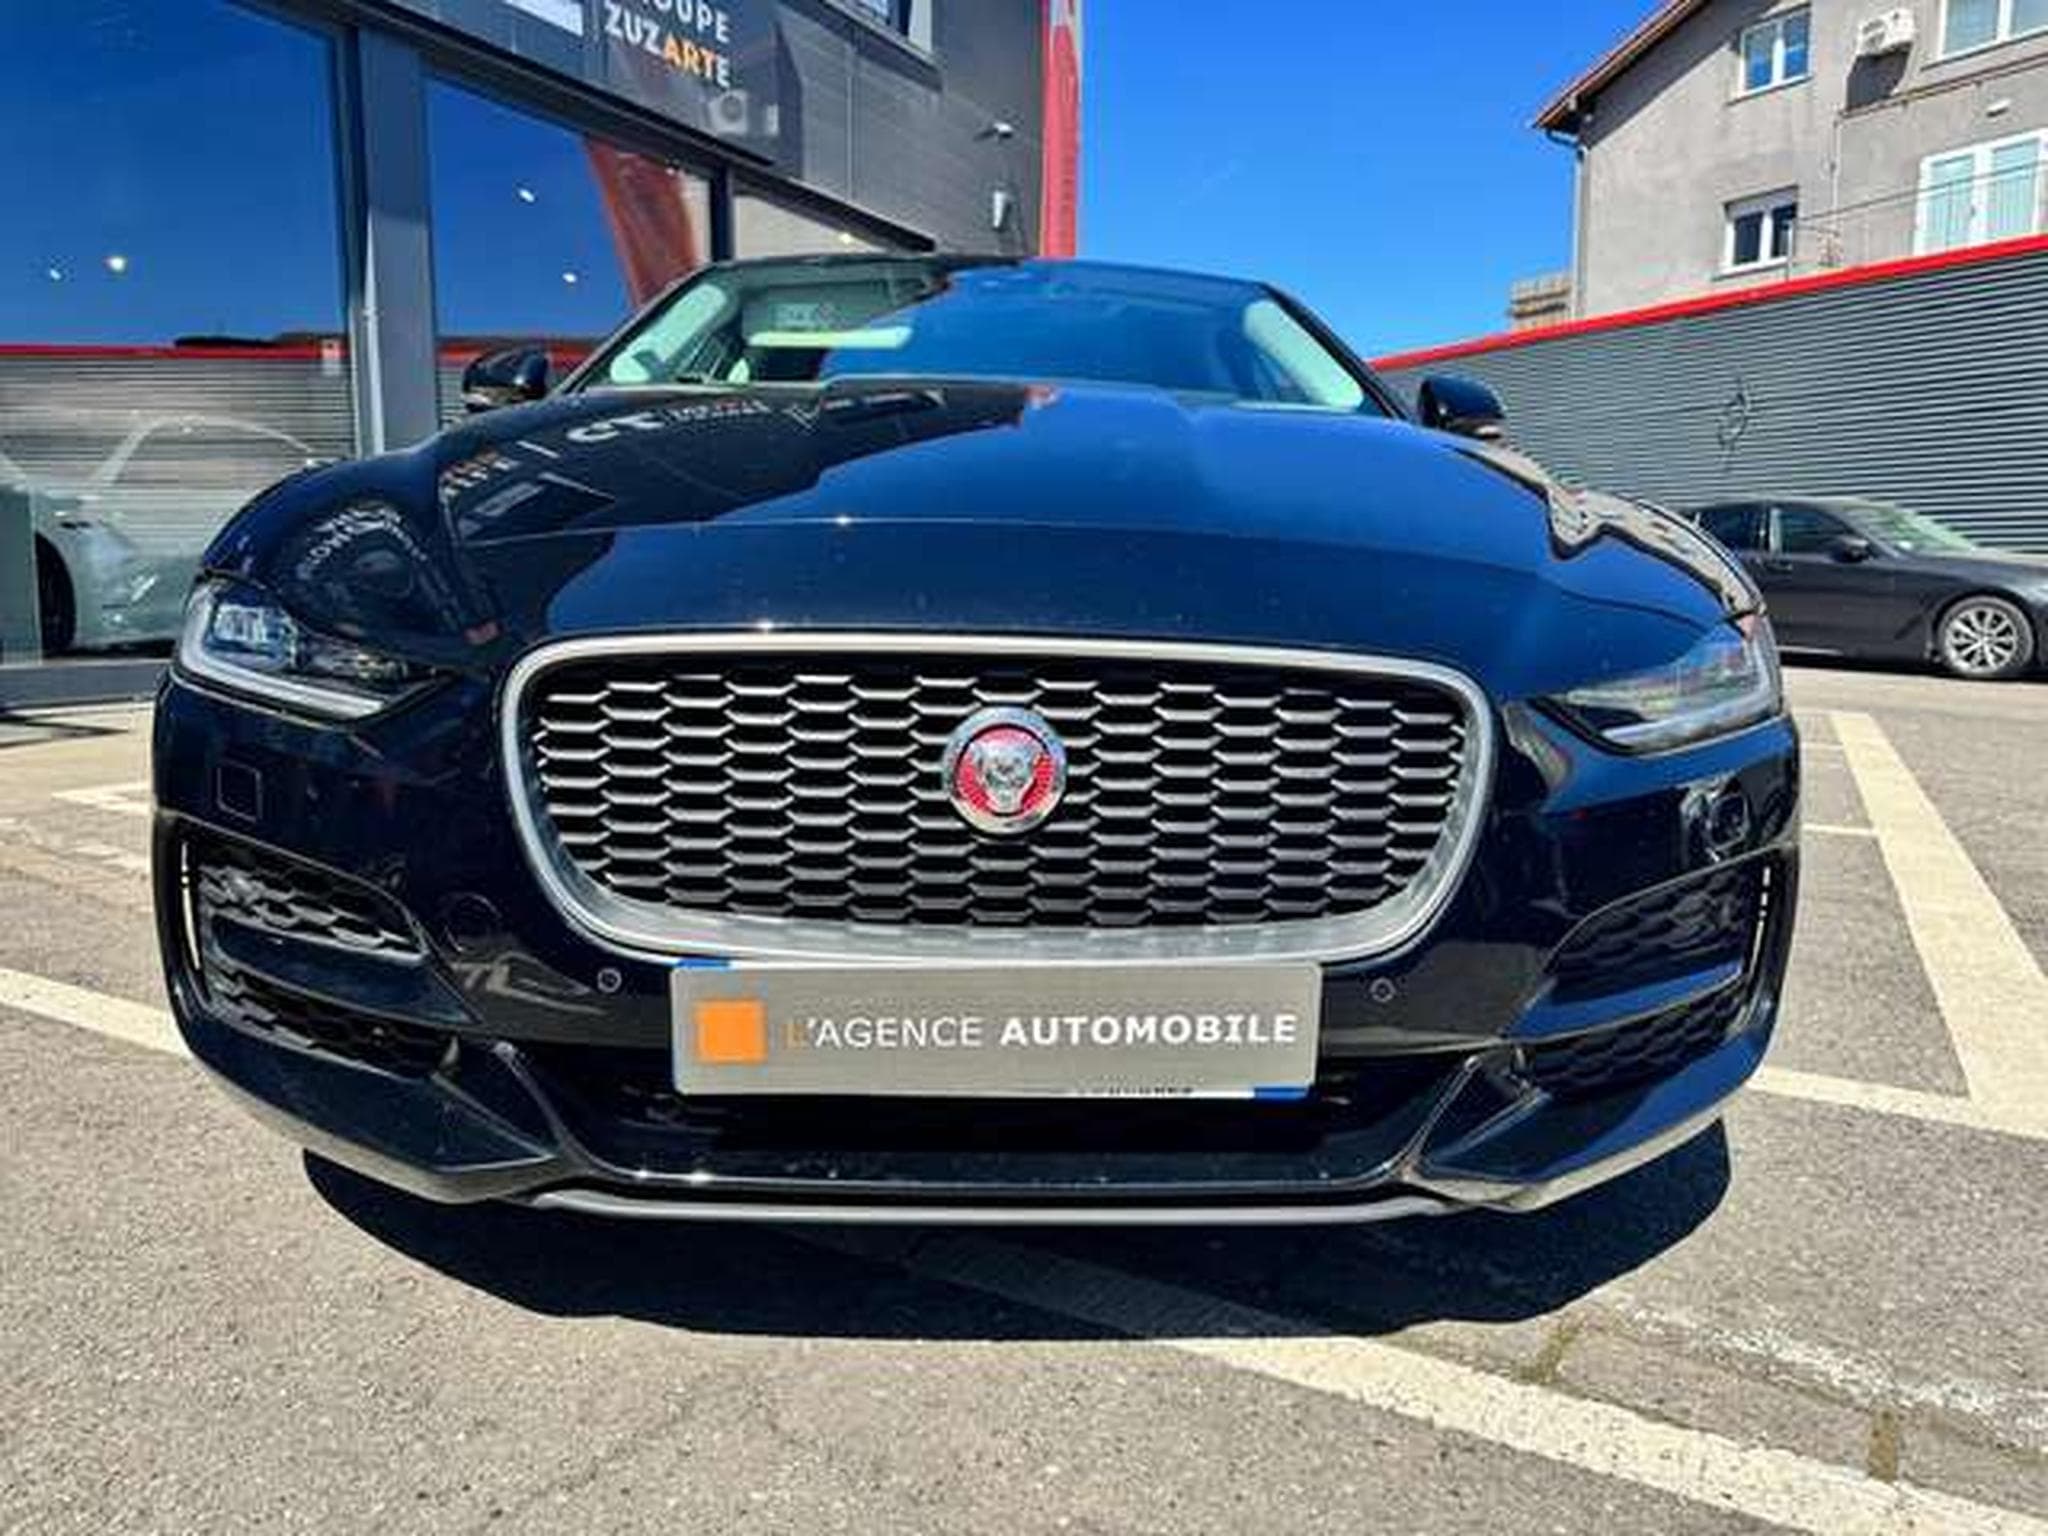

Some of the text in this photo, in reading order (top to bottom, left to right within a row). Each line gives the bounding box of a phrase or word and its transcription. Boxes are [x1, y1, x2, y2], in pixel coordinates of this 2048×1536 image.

[643, 0, 730, 43] UPE
[604, 0, 730, 89] ZUZARTE
[787, 1014, 1298, 1048] L'AGENCE AUTOMOBILE
